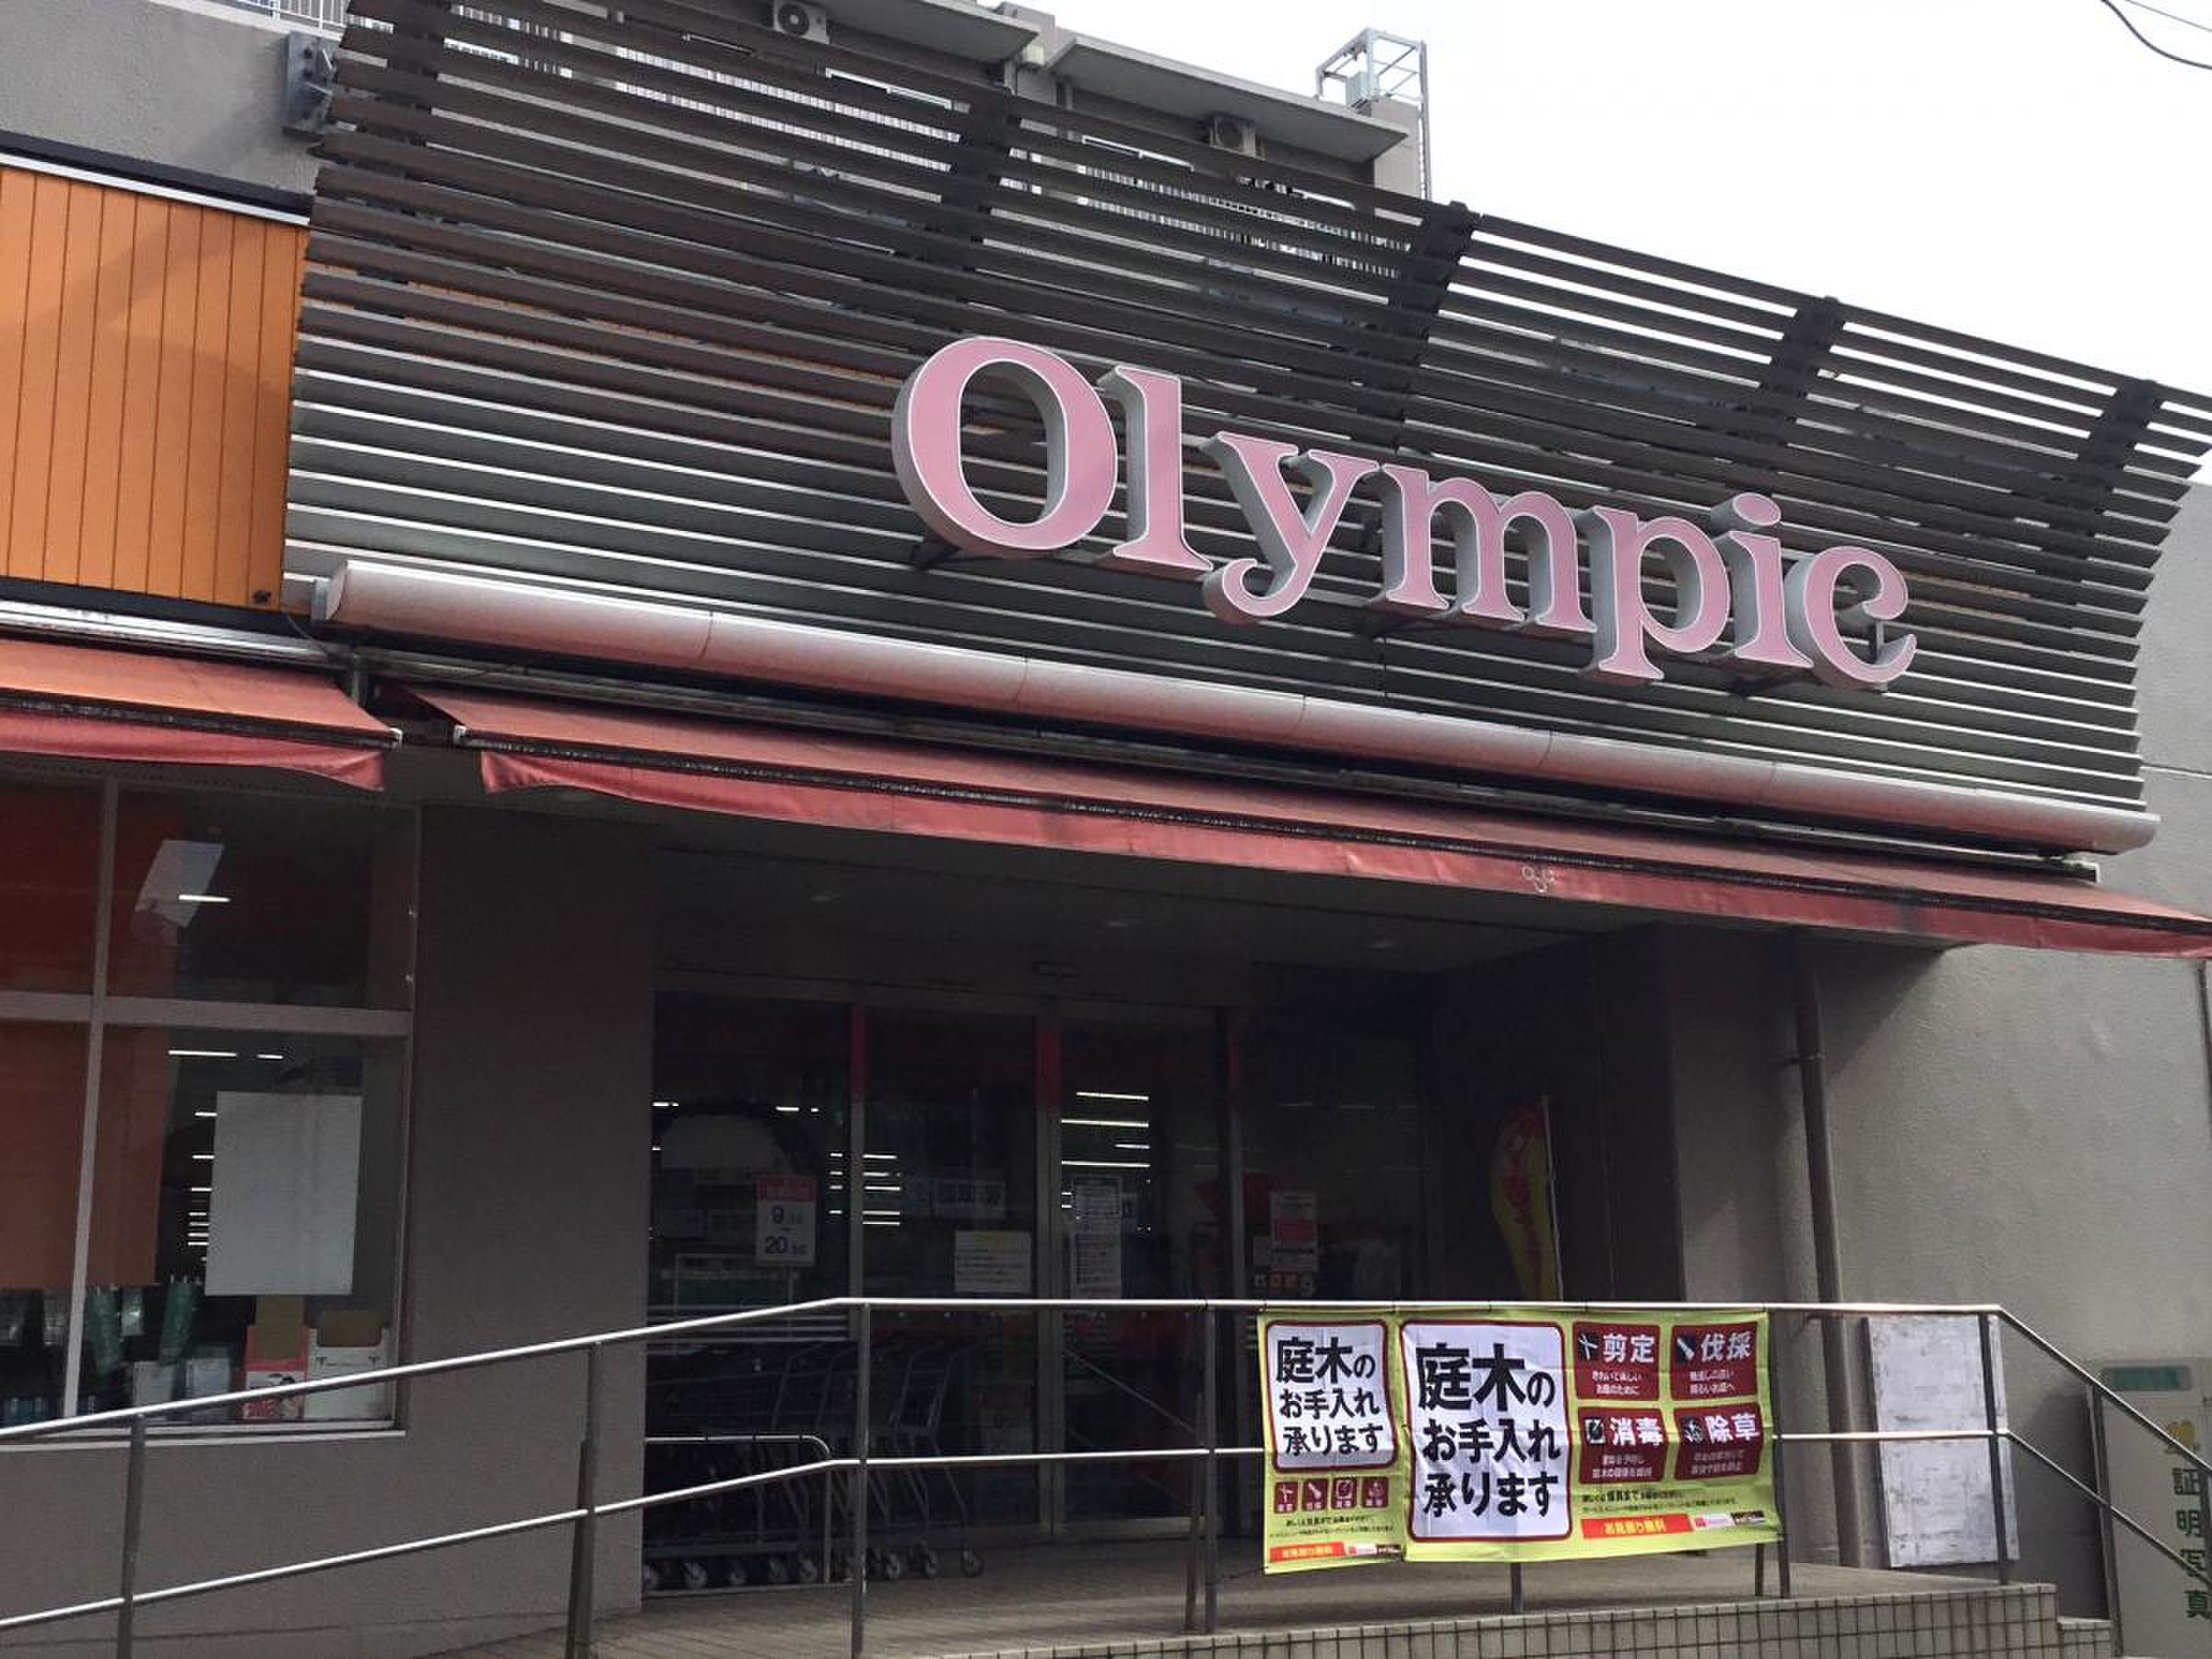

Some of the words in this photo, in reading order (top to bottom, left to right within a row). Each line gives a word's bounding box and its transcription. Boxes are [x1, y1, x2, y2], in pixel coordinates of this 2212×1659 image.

[892, 335, 1918, 689] Olympic
[1277, 1335, 1377, 1384] 庭木の
[1602, 1333, 1655, 1364] 剪定
[1700, 1331, 1752, 1362] 伐採
[1416, 1342, 1556, 1412] 庭木の
[1279, 1387, 1382, 1420] お手入れ
[1282, 1422, 1384, 1456] 承ります
[1421, 1418, 1562, 1465] お手入れ
[1609, 1415, 1665, 1446] 消毒
[1704, 1412, 1759, 1444] 除草
[1423, 1471, 1559, 1519] 承ります
